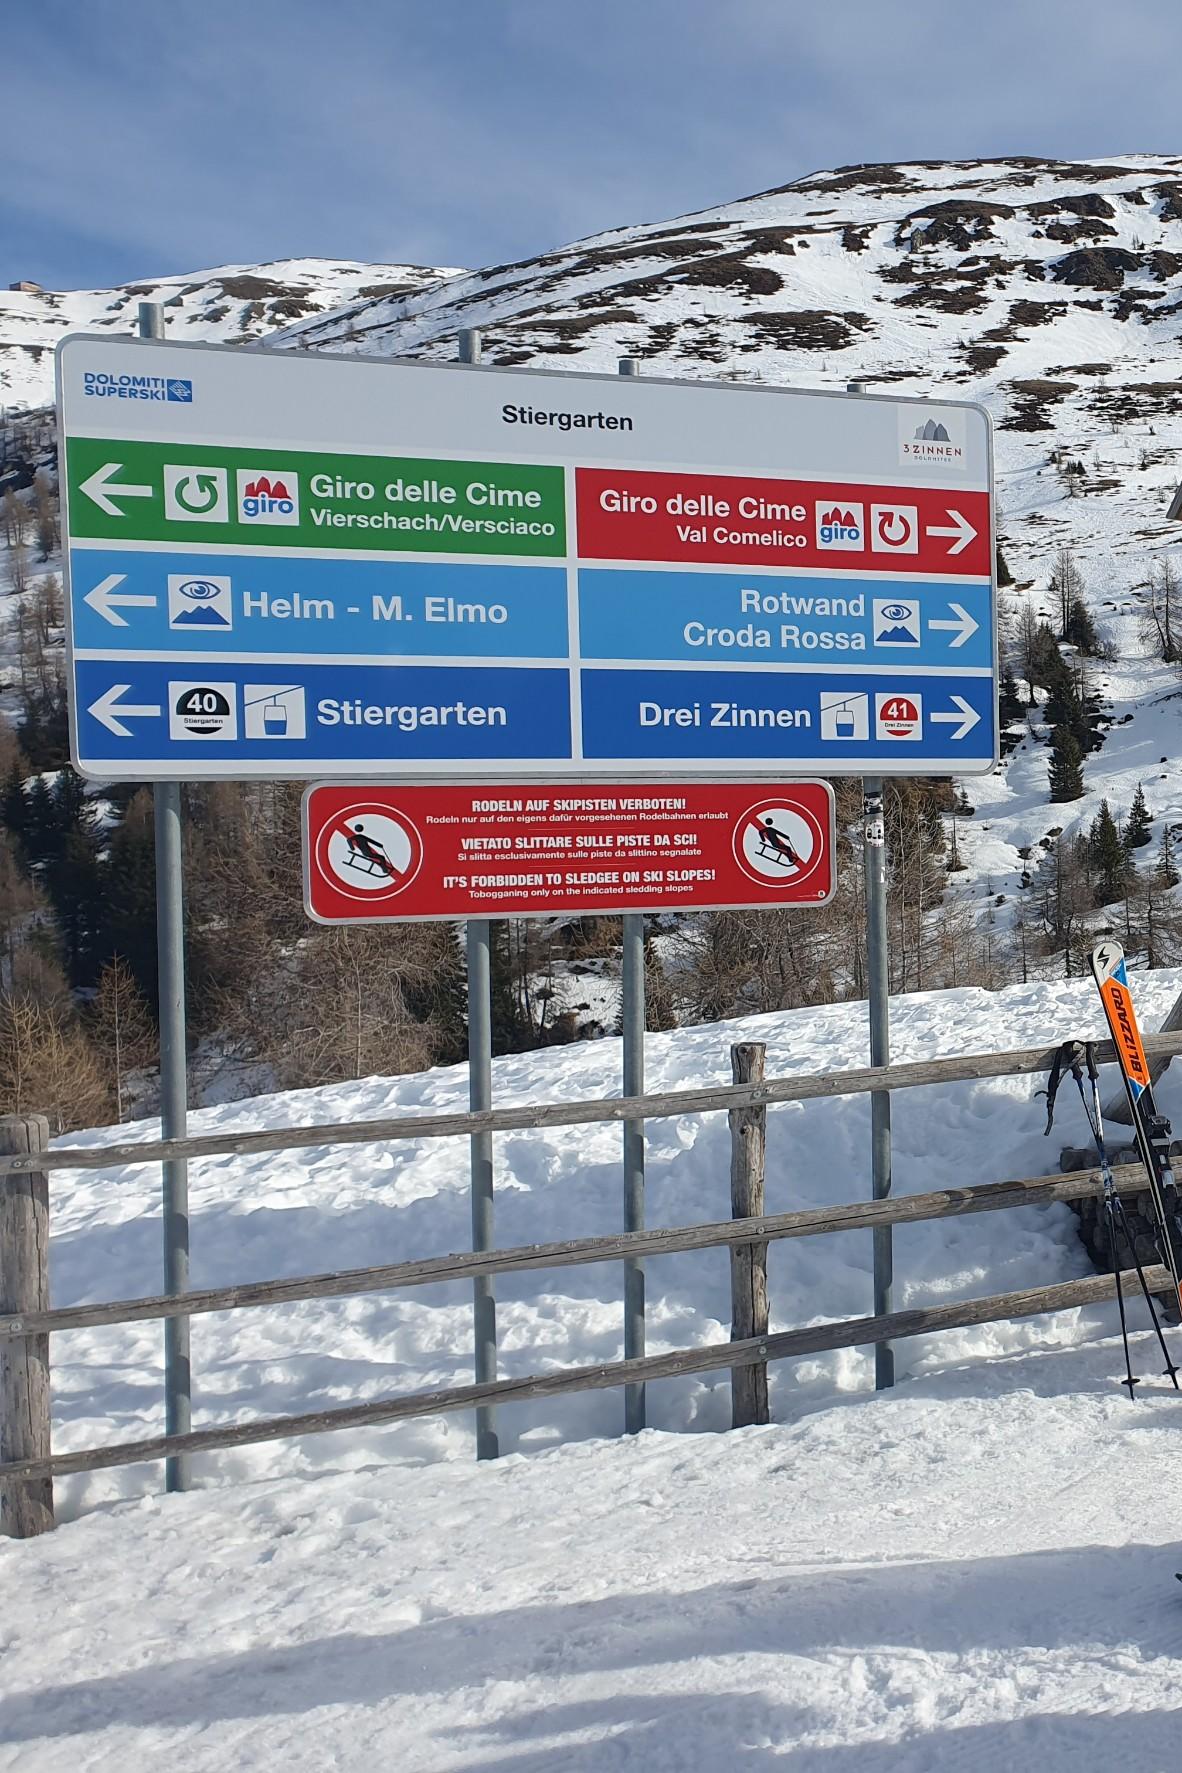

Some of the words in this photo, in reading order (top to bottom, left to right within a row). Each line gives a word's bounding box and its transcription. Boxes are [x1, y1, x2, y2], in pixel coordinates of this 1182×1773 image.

[84, 372, 165, 388] DOLOMITI
[84, 384, 165, 400] SUPERSKI
[502, 404, 633, 431] Stiergarten
[903, 443, 910, 454] 3
[912, 444, 962, 456] ZINNEN
[310, 474, 375, 501] Giro
[384, 480, 457, 505] delle
[466, 482, 542, 508] Cime
[242, 497, 294, 517] giro
[599, 490, 657, 514] Giro
[666, 494, 730, 518] delle
[738, 497, 806, 521] Cime
[310, 508, 556, 536] Vierschach/Versciaco
[676, 525, 708, 542] Val
[712, 528, 808, 548] Comelico
[820, 523, 860, 544] giro
[242, 591, 334, 620] Helm
[372, 596, 412, 622] M.
[425, 597, 508, 624] Elmo
[740, 590, 864, 617] Rotwand
[683, 622, 770, 648] Croda
[780, 625, 866, 650] Rossa
[187, 694, 218, 713] 40
[887, 702, 910, 718] 41
[184, 717, 224, 726] Stiergarten
[316, 698, 508, 732] Stiergarten
[640, 702, 700, 727] Drei
[711, 703, 811, 728] Zinnen
[472, 800, 522, 812] RODELN
[526, 800, 550, 812] AUF
[554, 799, 616, 811] SKIPISTEN
[620, 798, 686, 810] VERBOTEN!
[426, 815, 459, 824] Rodeln
[480, 814, 494, 822] auf
[497, 814, 514, 822] den
[517, 814, 546, 824] eigens
[549, 814, 572, 822] dafür
[575, 814, 637, 823] vorgesehenen
[640, 812, 697, 820] Rodelbahnen
[699, 812, 729, 820] erlaubt
[462, 838, 512, 850] VIETATO
[516, 837, 572, 850] SLITTARE
[576, 836, 614, 848] SULLE
[616, 835, 650, 848] PISTE
[654, 834, 670, 846] DA
[674, 834, 698, 846] SCI!
[458, 853, 468, 861] Si
[470, 852, 492, 860] slitta
[494, 851, 566, 860] esclusivamente
[568, 850, 588, 859] sulle
[590, 850, 612, 860] piste
[614, 850, 626, 858] da
[628, 849, 658, 858] slittino
[660, 848, 702, 859] segnalate
[444, 876, 468, 888] IT'S
[471, 874, 543, 888] FORBIDDEN
[546, 874, 562, 886] TO
[565, 872, 619, 884] SLEDGEE
[622, 872, 640, 883] ON
[642, 870, 664, 882] SKI
[666, 870, 716, 882] SLOPES!
[469, 890, 528, 900] Tobogganing
[530, 889, 550, 898] only
[566, 887, 580, 896] the
[582, 886, 624, 895] indicated
[626, 885, 663, 896] sledding
[665, 885, 694, 894] slopes
